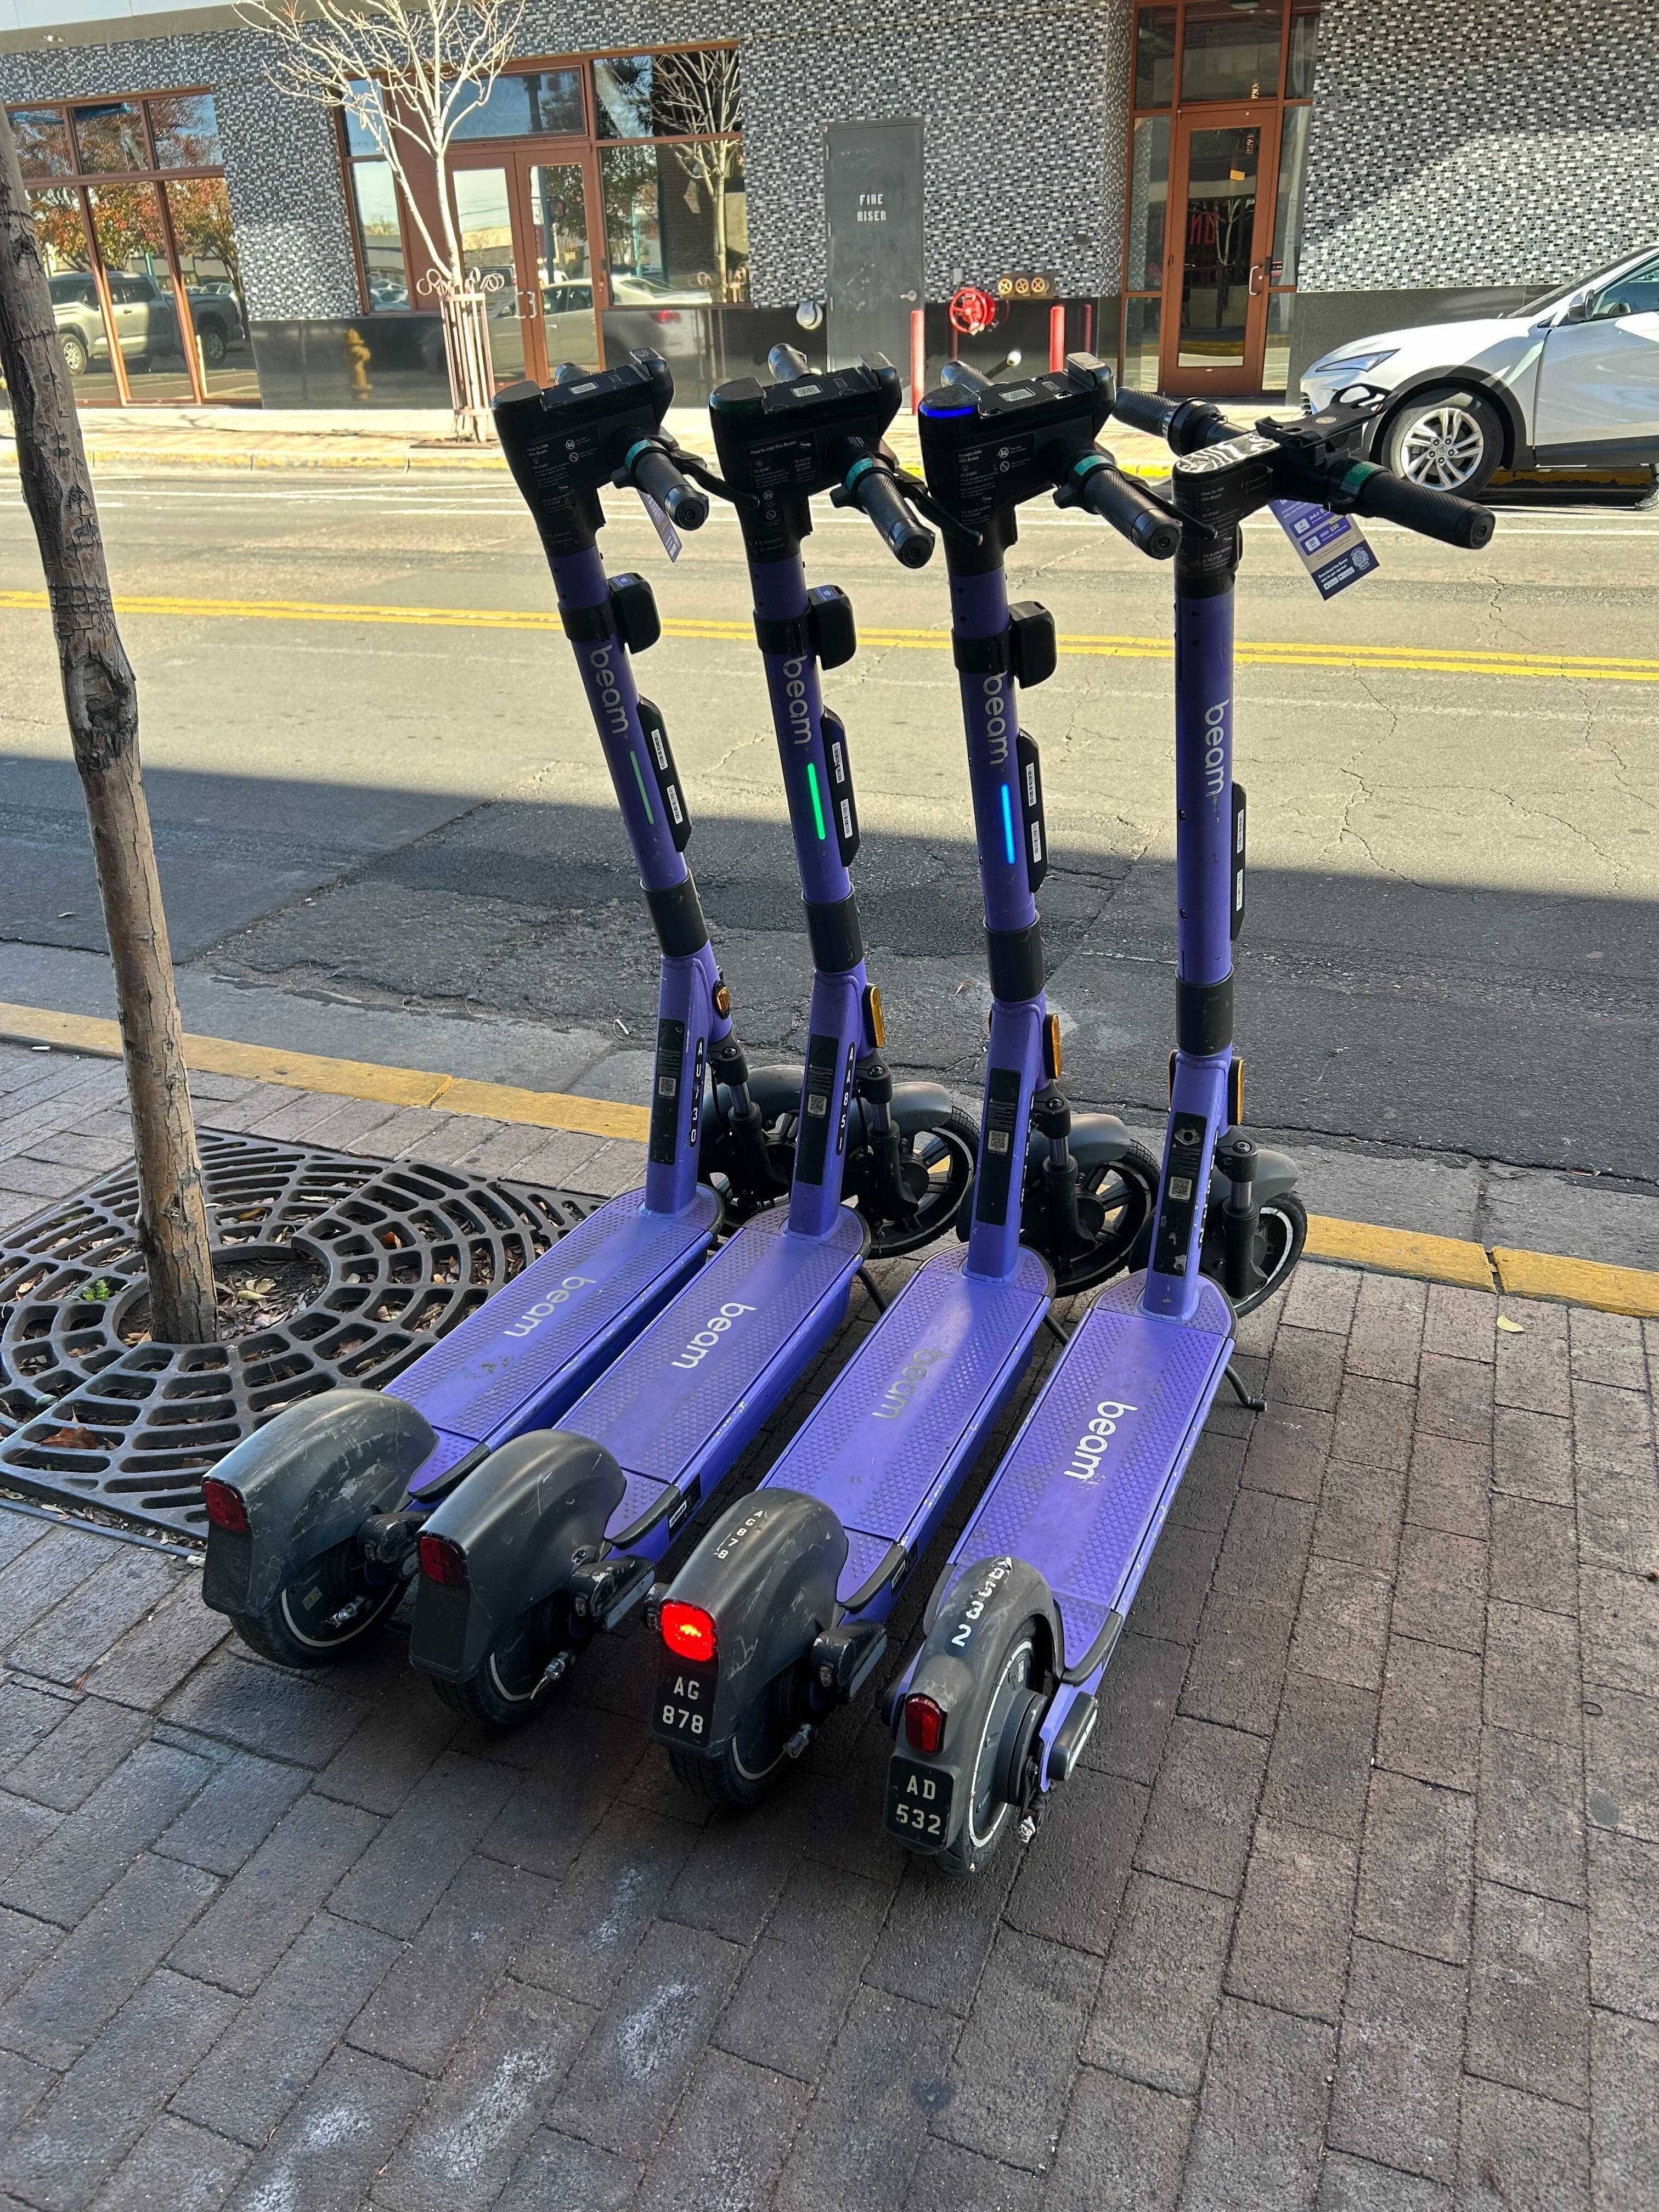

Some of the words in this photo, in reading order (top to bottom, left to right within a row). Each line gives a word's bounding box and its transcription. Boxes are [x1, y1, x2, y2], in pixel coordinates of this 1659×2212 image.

[857, 210, 887, 222] RISER
[859, 193, 883, 206] FIRE
[590, 644, 629, 733] beam
[782, 655, 812, 745] beam
[983, 670, 1009, 765] beam
[1204, 698, 1231, 797] beam
[503, 1275, 597, 1338] beam
[670, 1302, 758, 1369] beam
[872, 1349, 950, 1420] beam
[1064, 1400, 1139, 1481] beam
[716, 1509, 765, 1560] AG878
[673, 1675, 701, 1700] AG
[662, 1704, 704, 1735] 878
[906, 1774, 936, 1800] AD
[895, 1805, 941, 1836] 532
